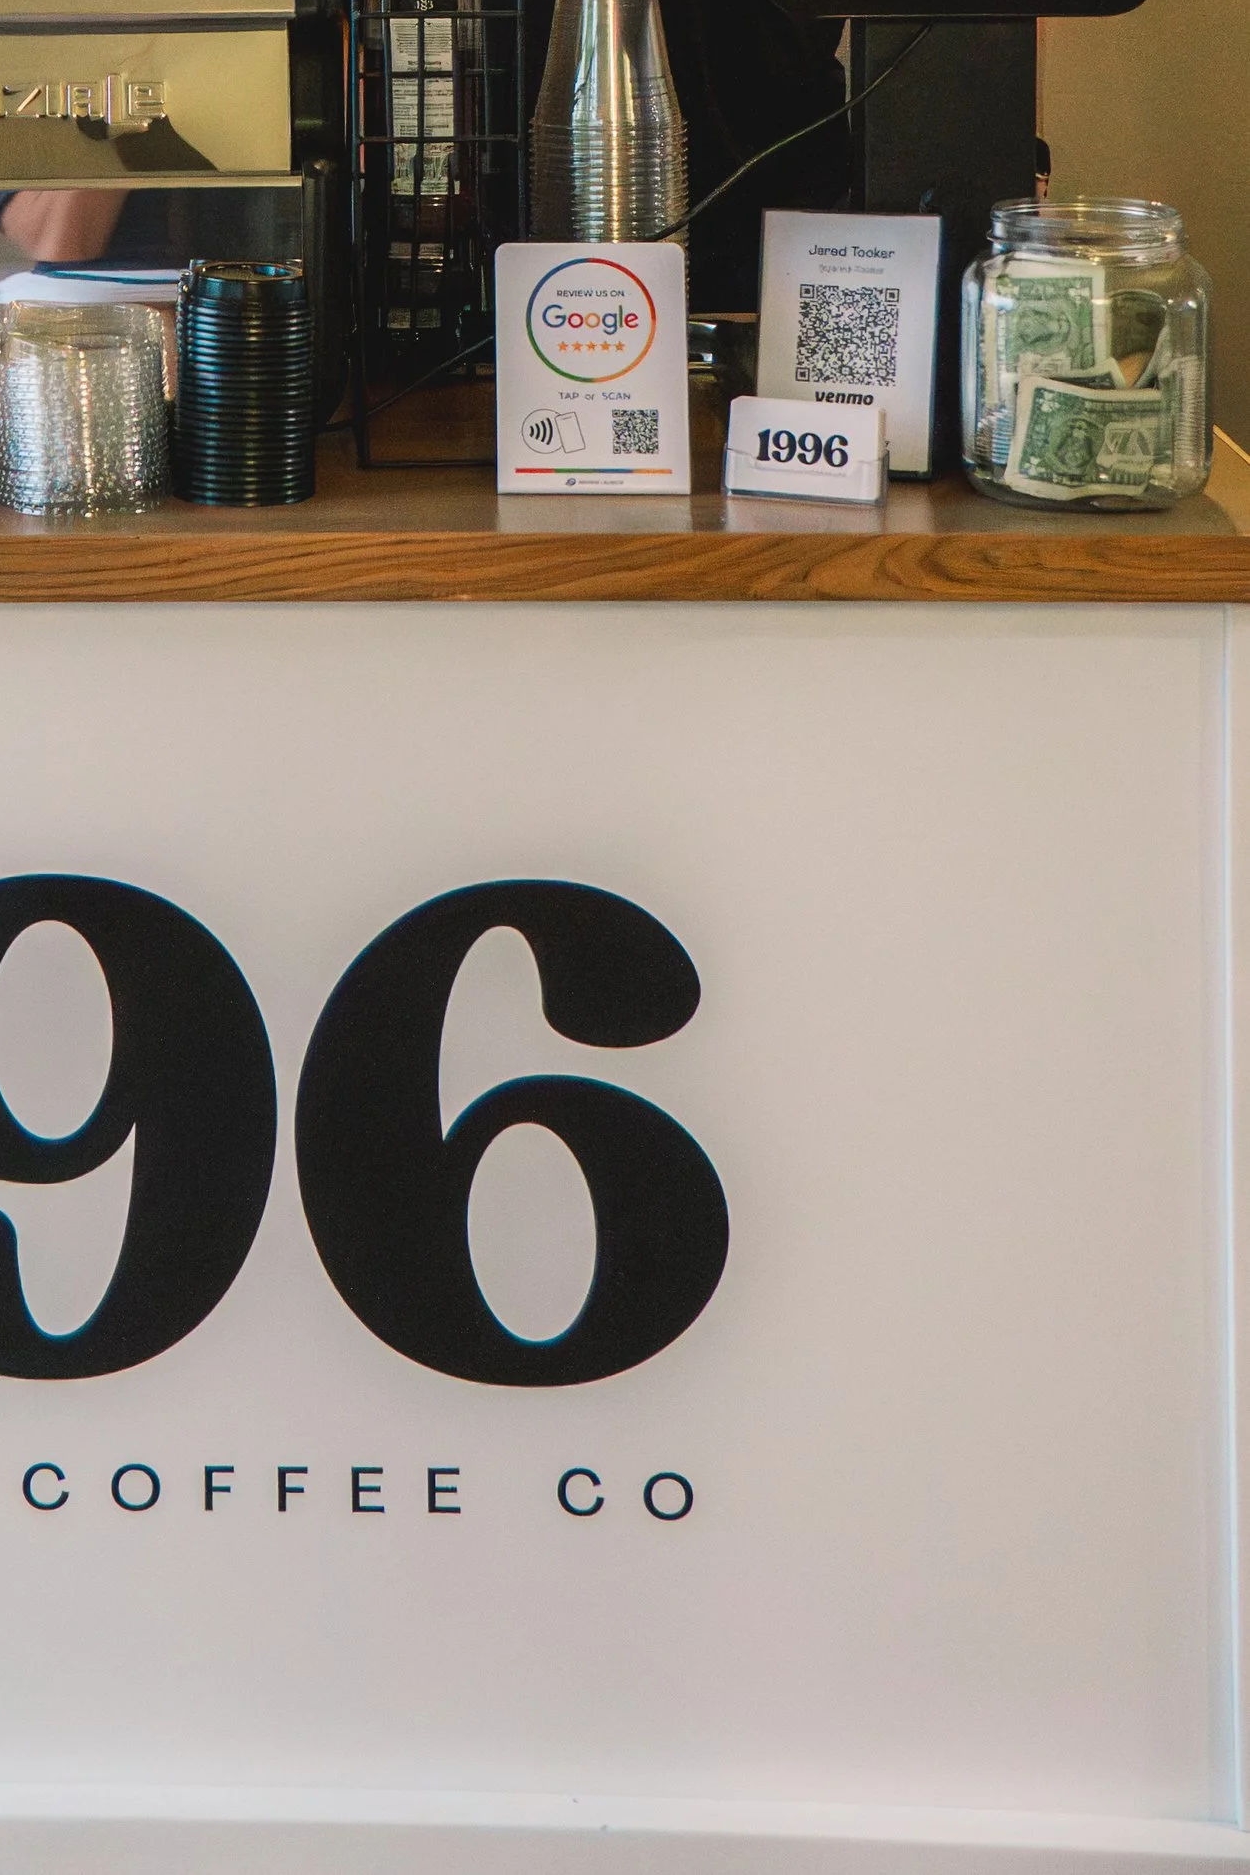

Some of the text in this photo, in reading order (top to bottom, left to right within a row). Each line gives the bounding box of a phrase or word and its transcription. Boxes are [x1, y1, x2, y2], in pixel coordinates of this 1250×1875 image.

[808, 244, 896, 259] Jared Tooker
[556, 289, 626, 298] REVIEW US ON
[542, 304, 640, 335] Google
[557, 391, 632, 401] TAP or SCAN
[814, 390, 875, 406] venmo
[756, 428, 850, 468] 1996
[21, 1462, 695, 1522] COFFEE CO
